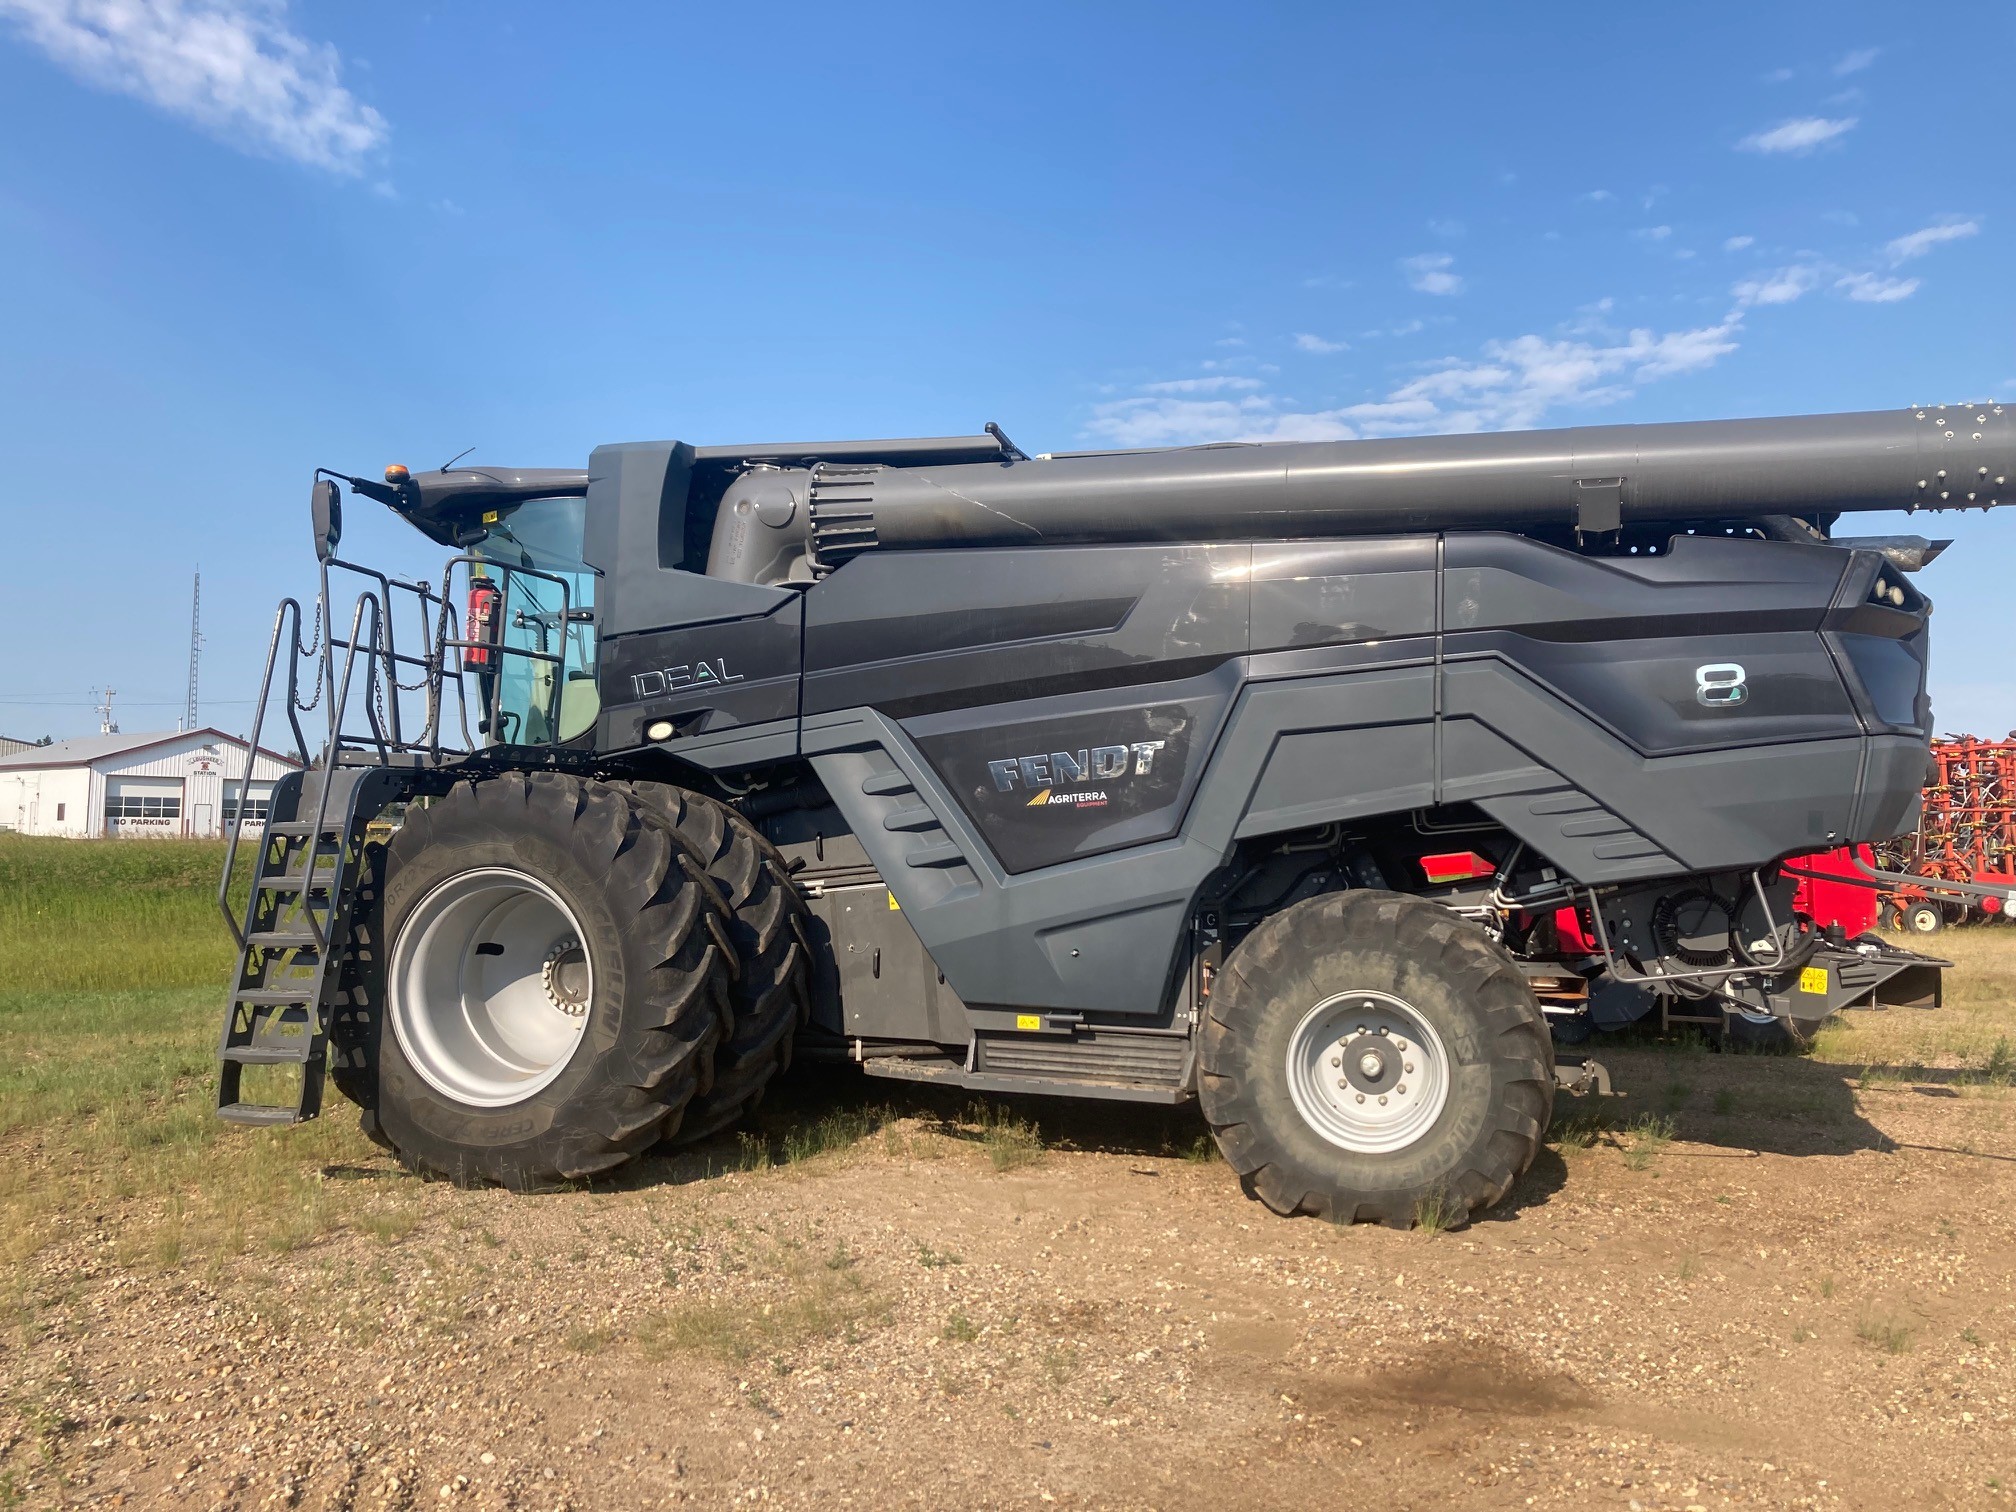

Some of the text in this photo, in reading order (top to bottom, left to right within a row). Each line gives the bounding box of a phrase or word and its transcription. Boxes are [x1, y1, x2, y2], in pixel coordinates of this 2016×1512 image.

[631, 658, 744, 701] IDEAL
[1696, 663, 1748, 708] 8
[988, 740, 1166, 792] FENDT
[1048, 791, 1107, 805] AGRITERRA
[113, 818, 171, 826] NO PARKING
